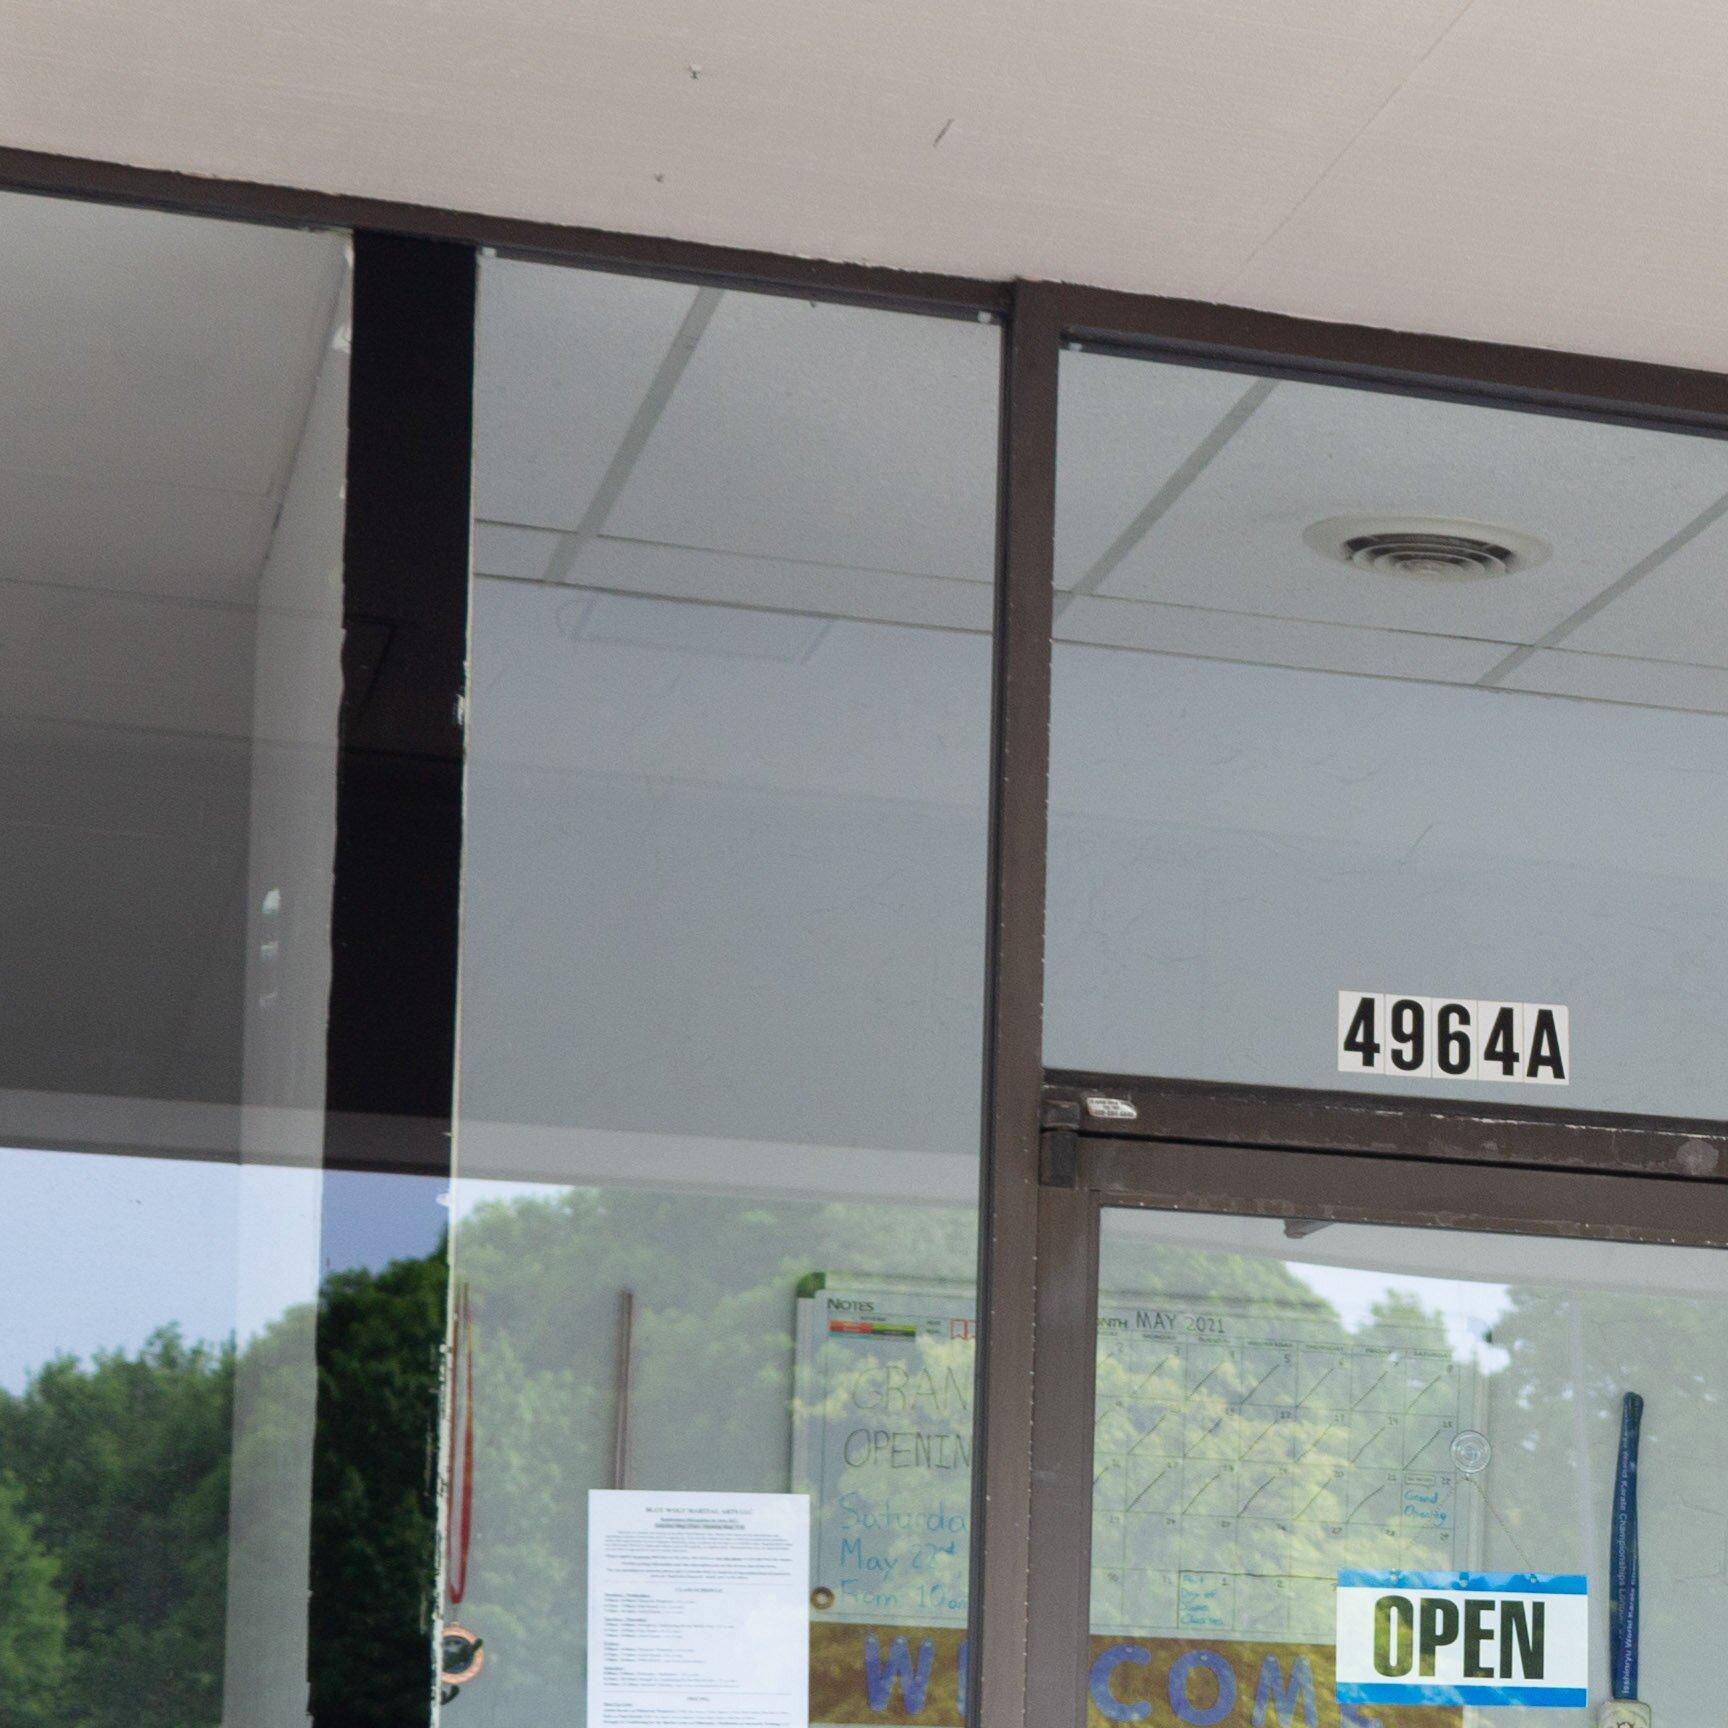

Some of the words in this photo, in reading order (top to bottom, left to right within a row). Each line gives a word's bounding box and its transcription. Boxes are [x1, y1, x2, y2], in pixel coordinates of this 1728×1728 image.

[1343, 997, 1566, 1080] 4964A
[1136, 1310, 1176, 1330] MAY
[1184, 1315, 1226, 1334] 2021
[1373, 1595, 1545, 1680] OPEN
